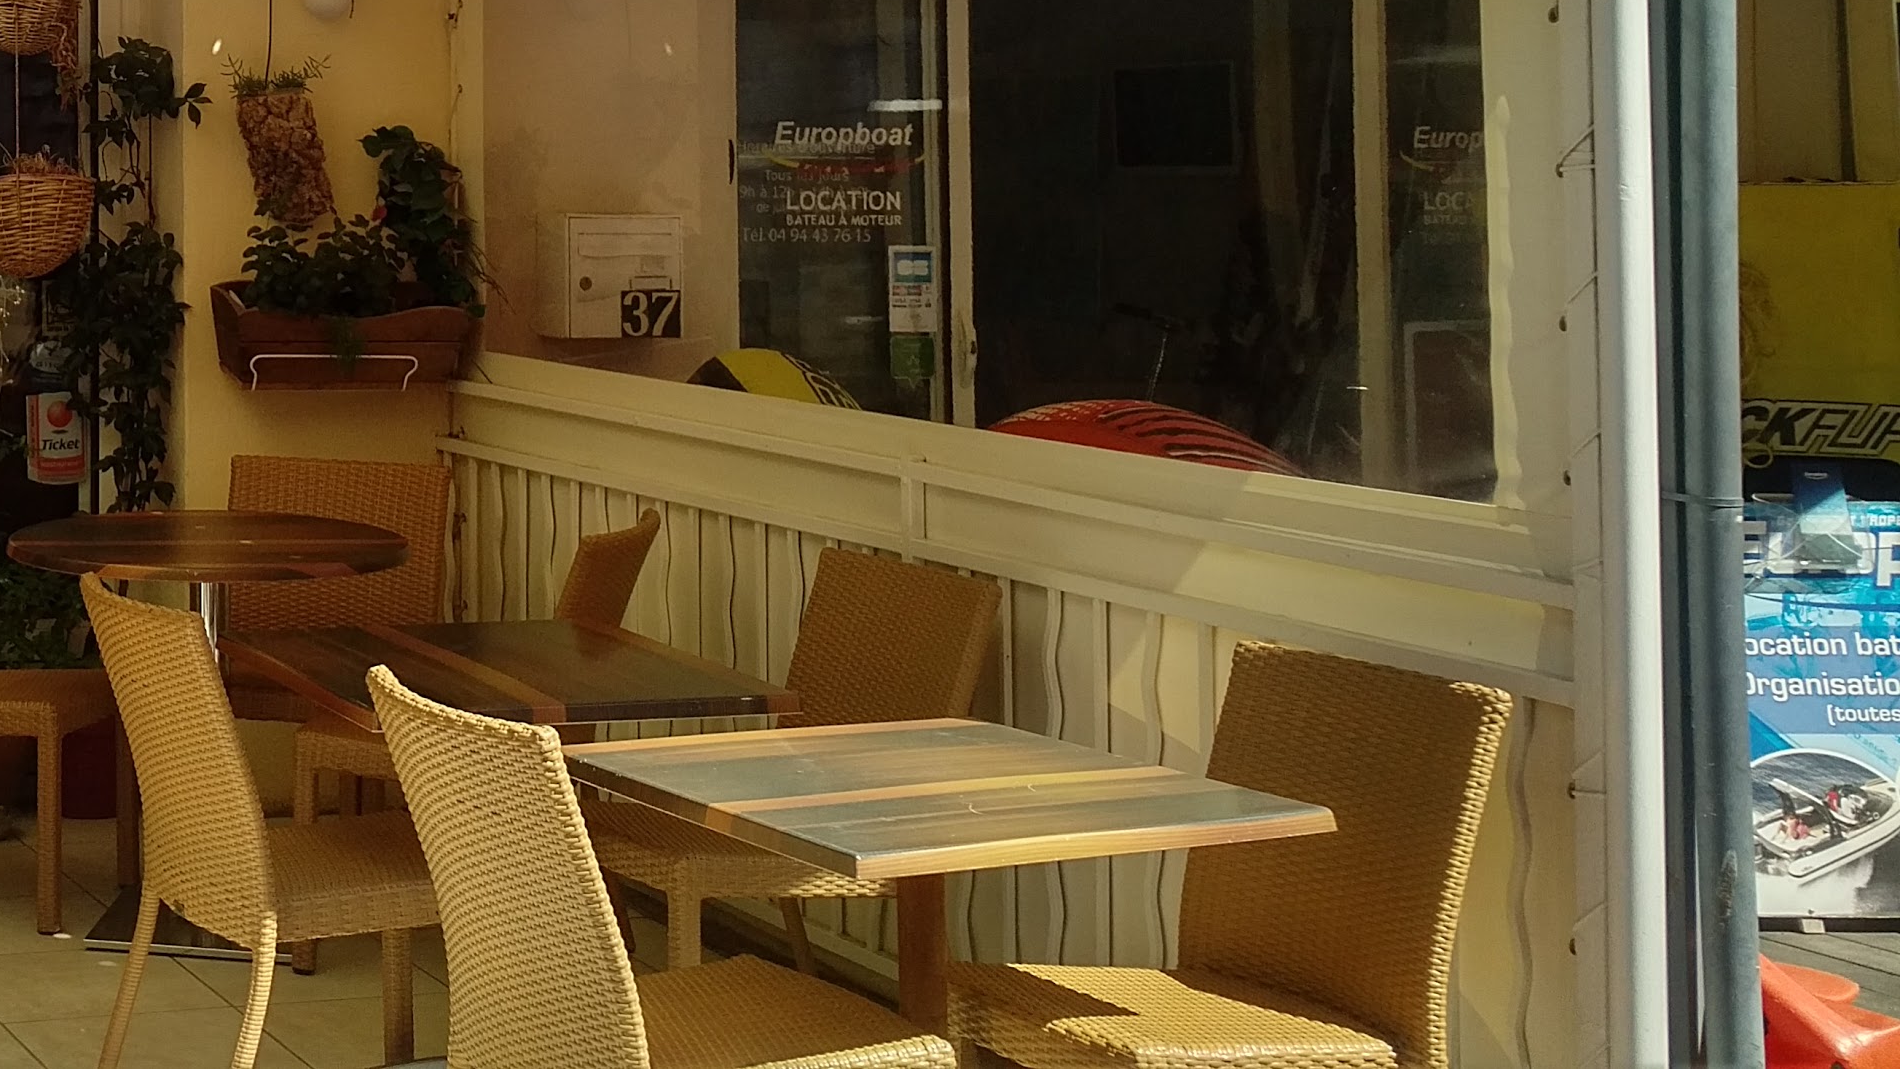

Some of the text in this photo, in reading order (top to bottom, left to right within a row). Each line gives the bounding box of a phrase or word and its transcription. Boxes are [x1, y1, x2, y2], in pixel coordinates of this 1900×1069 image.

[774, 121, 914, 150] Europboat
[786, 191, 901, 211] LOCATION
[786, 215, 836, 226] BATEAU
[851, 215, 902, 226] MOTEUR
[622, 292, 679, 337] 37
[41, 438, 80, 450] Ticket
